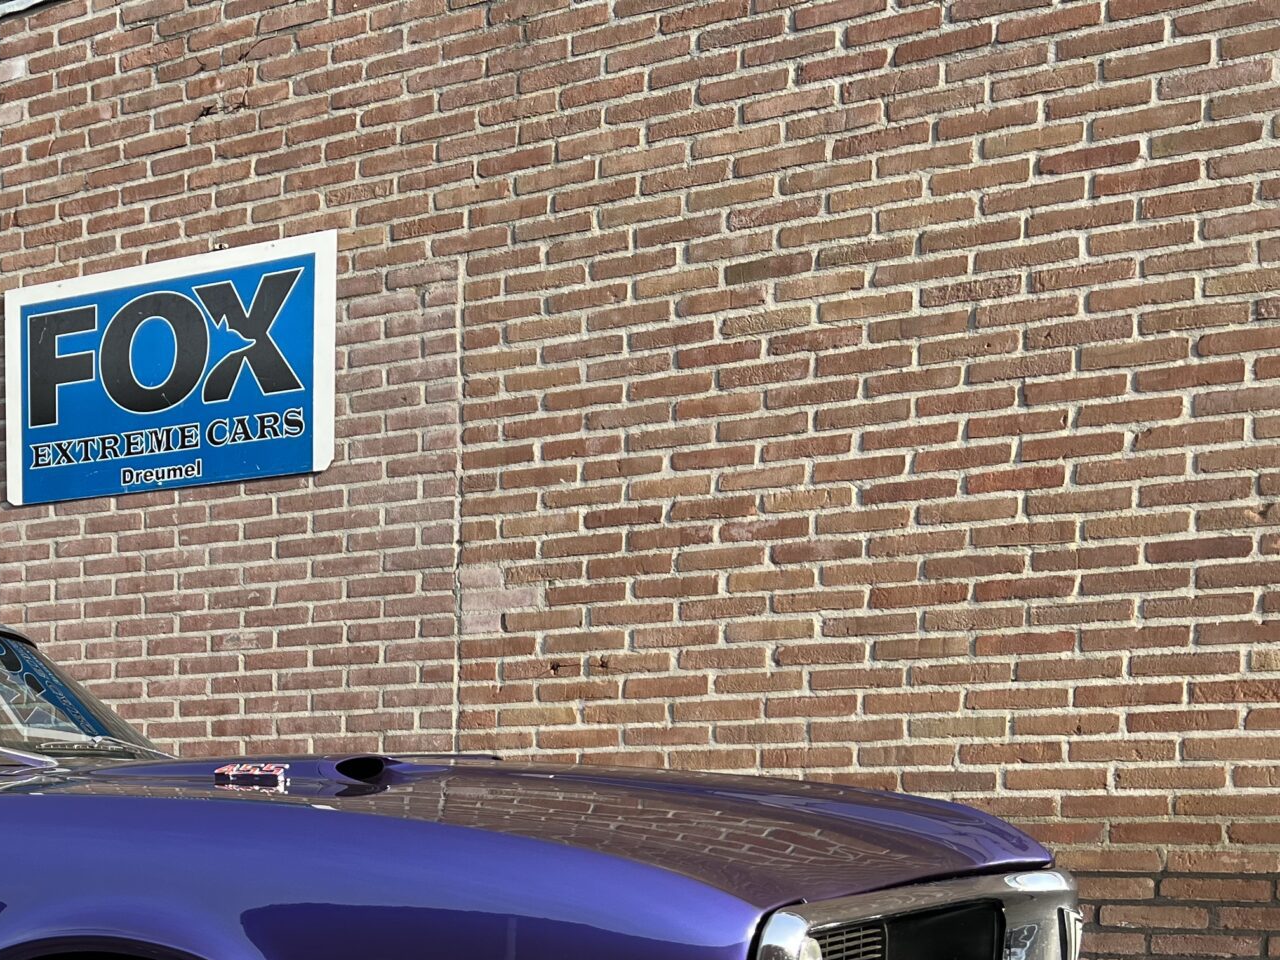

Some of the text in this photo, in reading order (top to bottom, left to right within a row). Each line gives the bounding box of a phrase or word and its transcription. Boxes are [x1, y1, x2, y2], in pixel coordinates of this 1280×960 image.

[27, 266, 306, 429] FOX
[29, 406, 306, 470] EXTREME CARS
[120, 459, 203, 486] Dreumel
